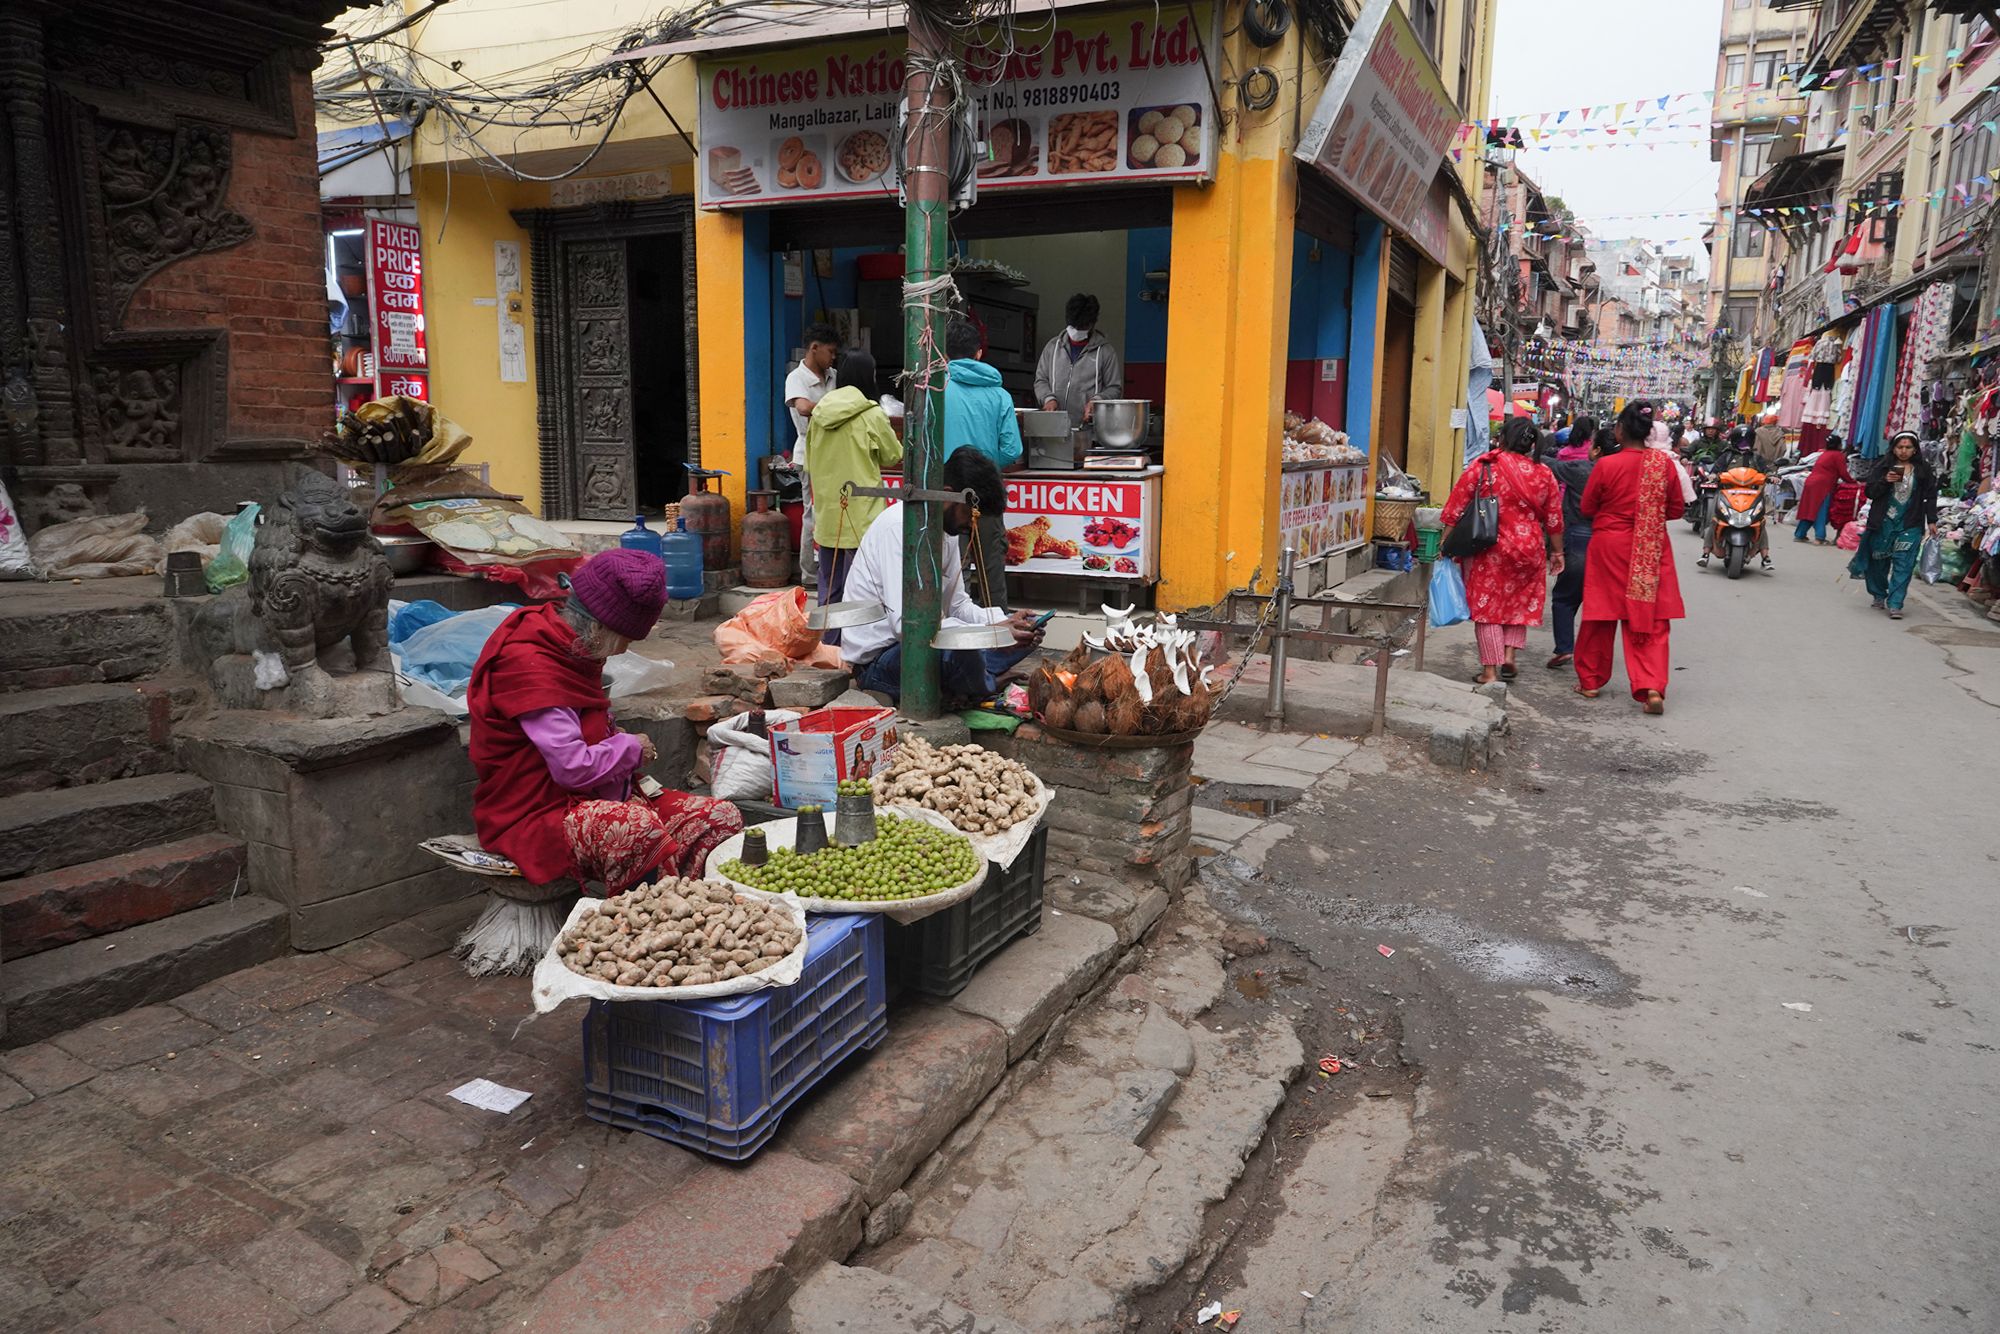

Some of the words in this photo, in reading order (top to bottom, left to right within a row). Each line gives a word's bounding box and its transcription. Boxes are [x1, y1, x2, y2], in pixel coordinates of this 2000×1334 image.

[713, 64, 819, 111] Chinese
[825, 48, 906, 97] Natio
[1051, 28, 1118, 78] Pvt.
[1128, 15, 1200, 71] Ltd.
[993, 91, 1018, 110] No.
[1023, 81, 1120, 107] 9818890403
[769, 108, 862, 131] Mangalbazar,
[376, 223, 419, 250] FIXED
[376, 246, 421, 274] PRICE
[384, 271, 416, 289] एक
[382, 290, 419, 309] दाम
[1006, 484, 1123, 513] CHICKEN
